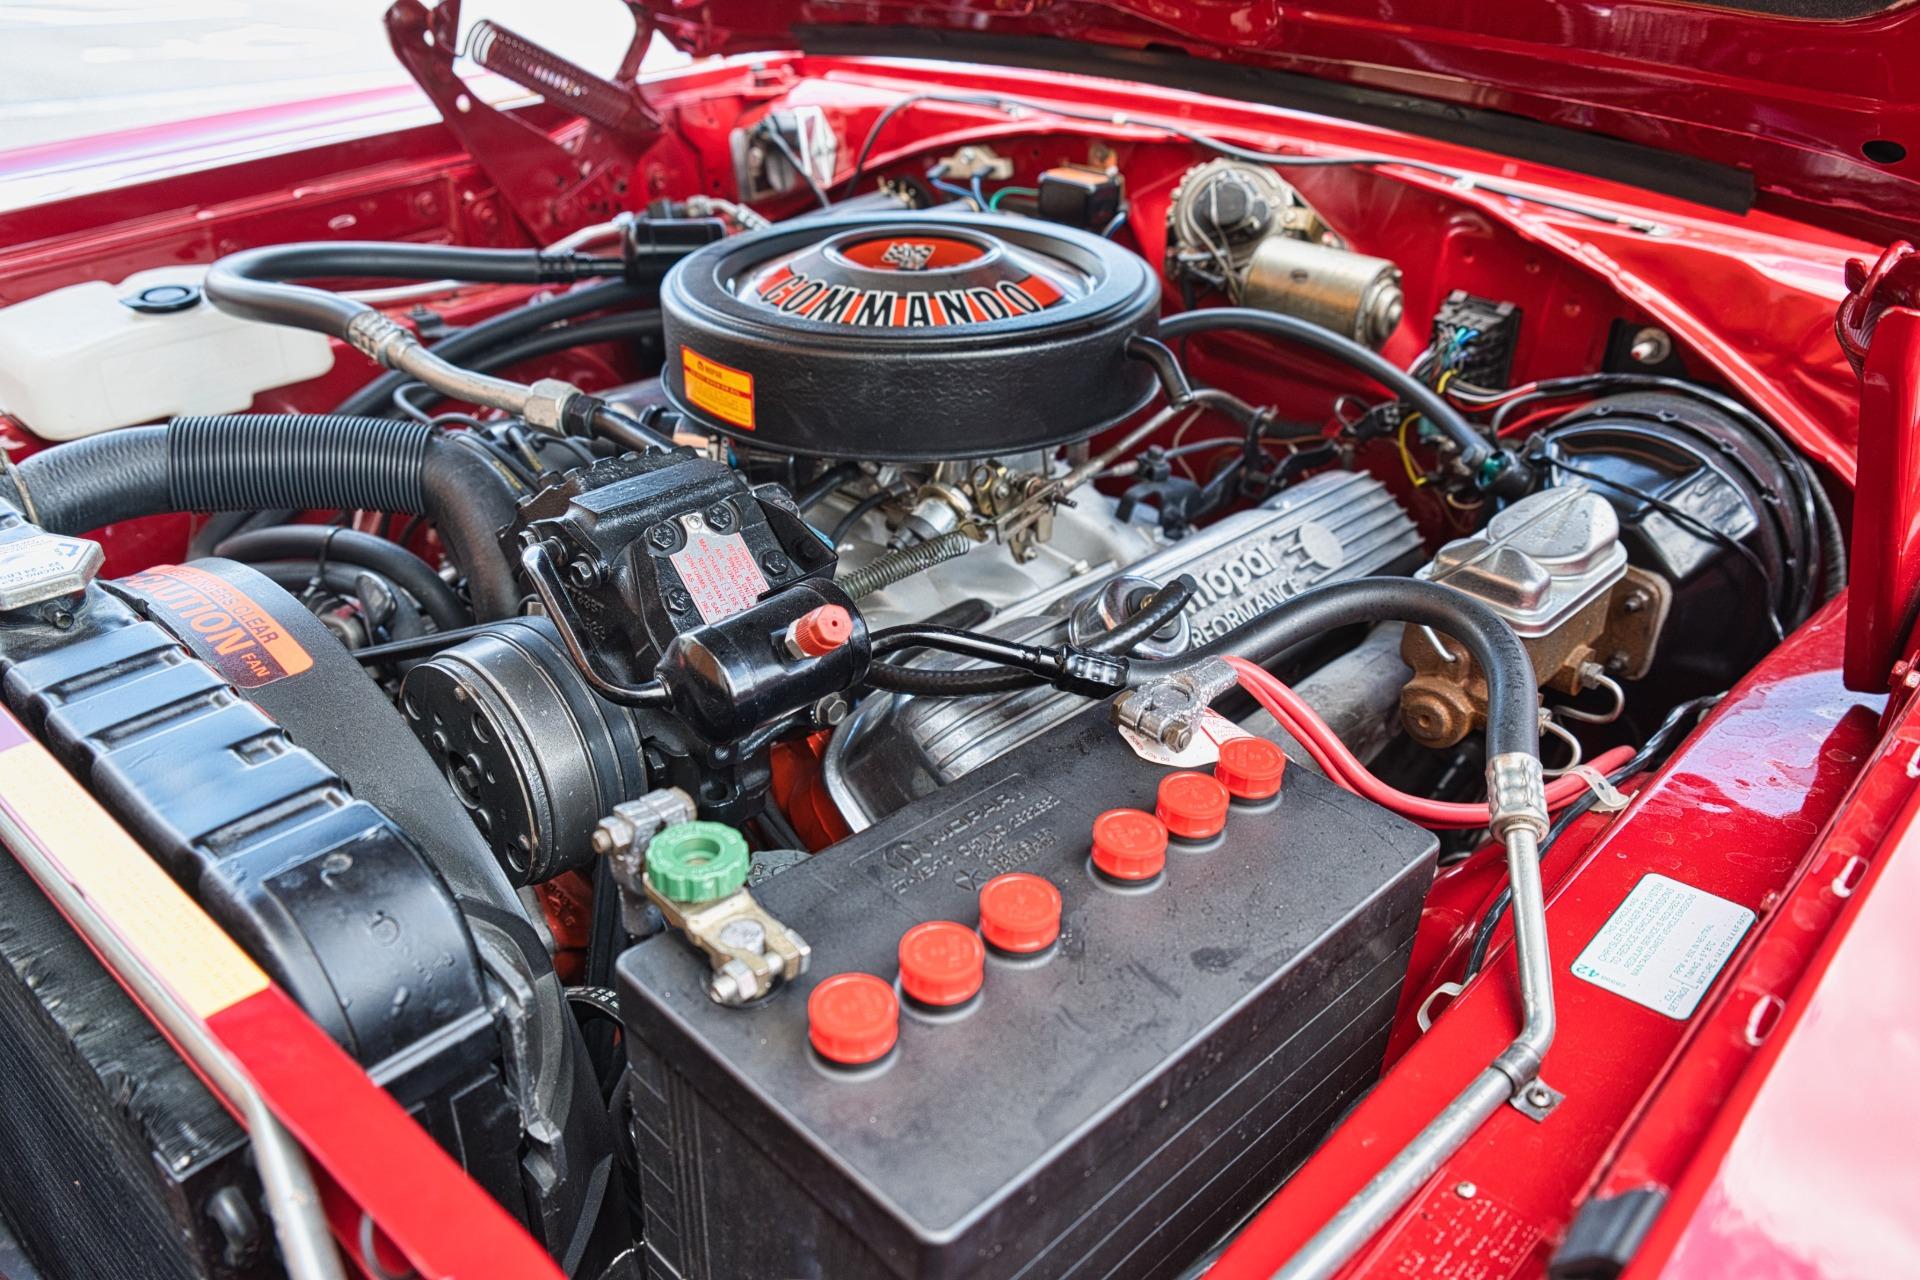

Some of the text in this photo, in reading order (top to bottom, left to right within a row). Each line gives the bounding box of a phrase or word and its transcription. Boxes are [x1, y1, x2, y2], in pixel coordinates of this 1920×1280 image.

[761, 273, 1044, 327] COMMANDO
[685, 553, 706, 589] CONFORMS
[704, 590, 714, 601] TO
[698, 557, 725, 602] REFRIGERANT
[727, 556, 753, 598] SINGLE UNIT
[728, 543, 744, 570] DETROIT
[124, 573, 271, 678] CAUTION FAN
[232, 605, 280, 645] CLEAR
[1597, 932, 1624, 962] CHRYSLER
[1620, 910, 1642, 933] CLEANER
[1643, 882, 1664, 903] SYSTEM
[1609, 955, 1623, 966] TO
[1616, 933, 1639, 957] REDUCE
[1634, 912, 1655, 934] VEHICLE
[1649, 887, 1675, 914] EMISSIONS
[1623, 945, 1645, 969] REGULAR
[1641, 925, 1660, 946] SERVICE
[1659, 899, 1680, 922] REQUIRED
[1631, 893, 1697, 977] MAINTAIN LOWEST VEHICLE EMISSIONS
[1695, 922, 1714, 944] NEUTRAL
